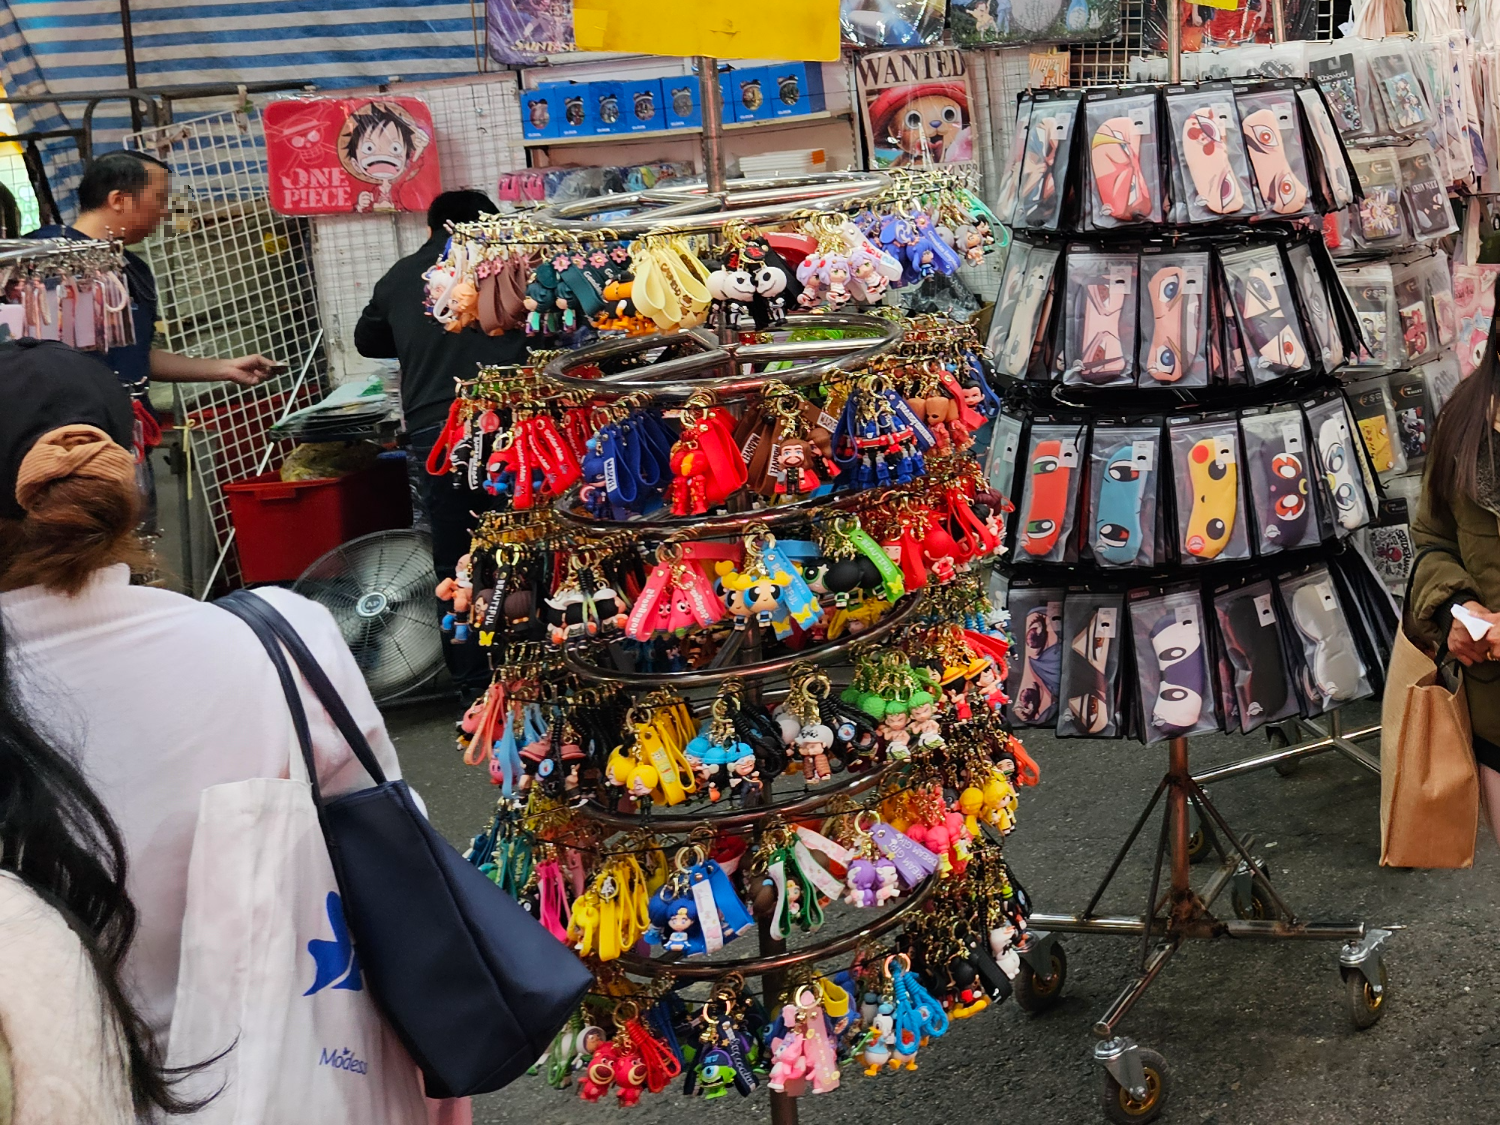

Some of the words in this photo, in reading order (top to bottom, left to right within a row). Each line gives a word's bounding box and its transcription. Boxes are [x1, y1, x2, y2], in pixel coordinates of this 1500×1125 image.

[856, 49, 966, 87] WANTED
[281, 167, 350, 189] ONE
[283, 187, 352, 209] PIECE
[860, 539, 894, 575] BEAUTIFUL
[485, 579, 505, 625] BEAUTIFUL
[912, 844, 938, 866] DREAM
